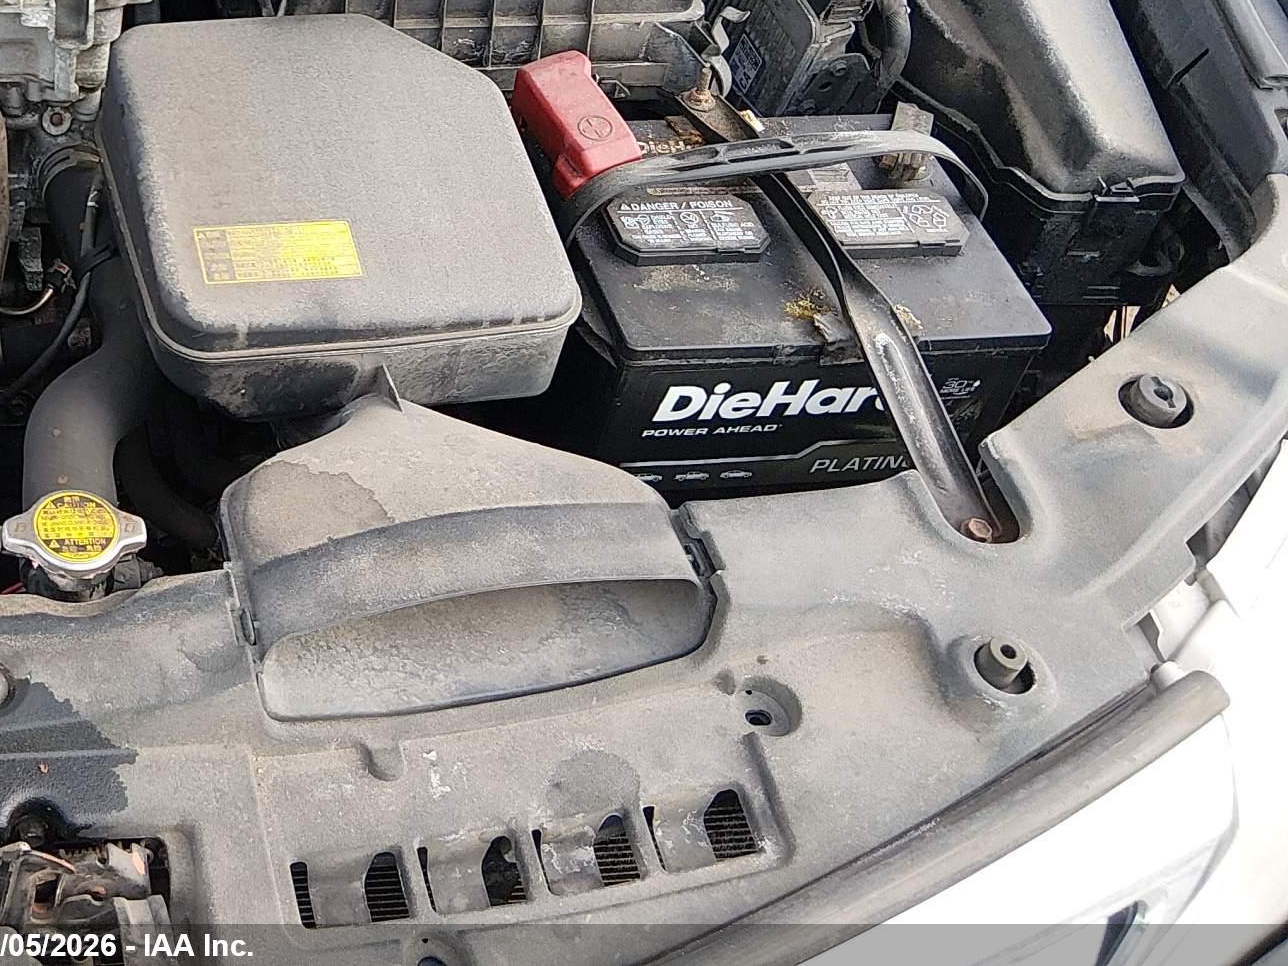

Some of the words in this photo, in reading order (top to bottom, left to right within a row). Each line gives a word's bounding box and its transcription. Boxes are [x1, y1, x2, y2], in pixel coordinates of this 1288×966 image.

[630, 201, 679, 211] DANGER
[690, 199, 733, 209] POISON
[642, 427, 708, 438] POWER
[713, 424, 779, 435] AHEAD
[810, 455, 910, 474] PLATIN
[64, 538, 106, 546] ATTENTION
